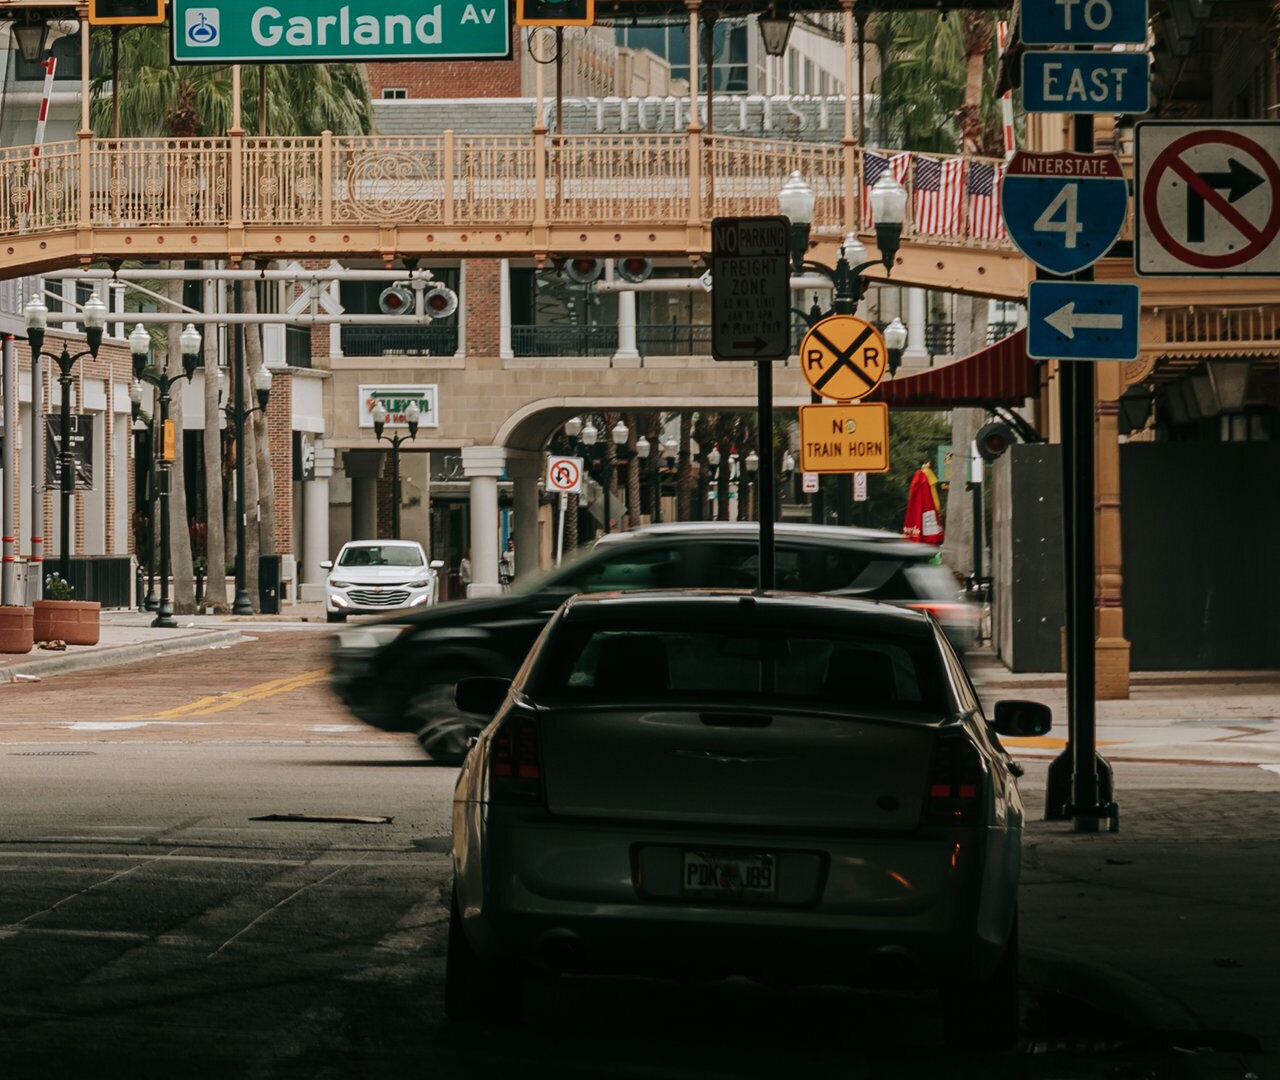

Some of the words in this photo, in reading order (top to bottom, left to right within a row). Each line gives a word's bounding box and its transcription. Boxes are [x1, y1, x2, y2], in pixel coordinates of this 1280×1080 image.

[250, 3, 443, 47] Garland
[460, 4, 497, 26] Av
[1042, 62, 1128, 102] EAST
[1021, 157, 1109, 176] INTERSTATE
[1033, 183, 1084, 249] 4
[715, 227, 738, 254] NO
[739, 227, 785, 250] PARKING
[721, 258, 778, 277] FREIGHT
[731, 279, 768, 296] ZONE
[807, 350, 825, 370] R
[862, 347, 879, 368] R
[807, 442, 842, 458] TRAIN
[848, 441, 883, 457] HORN
